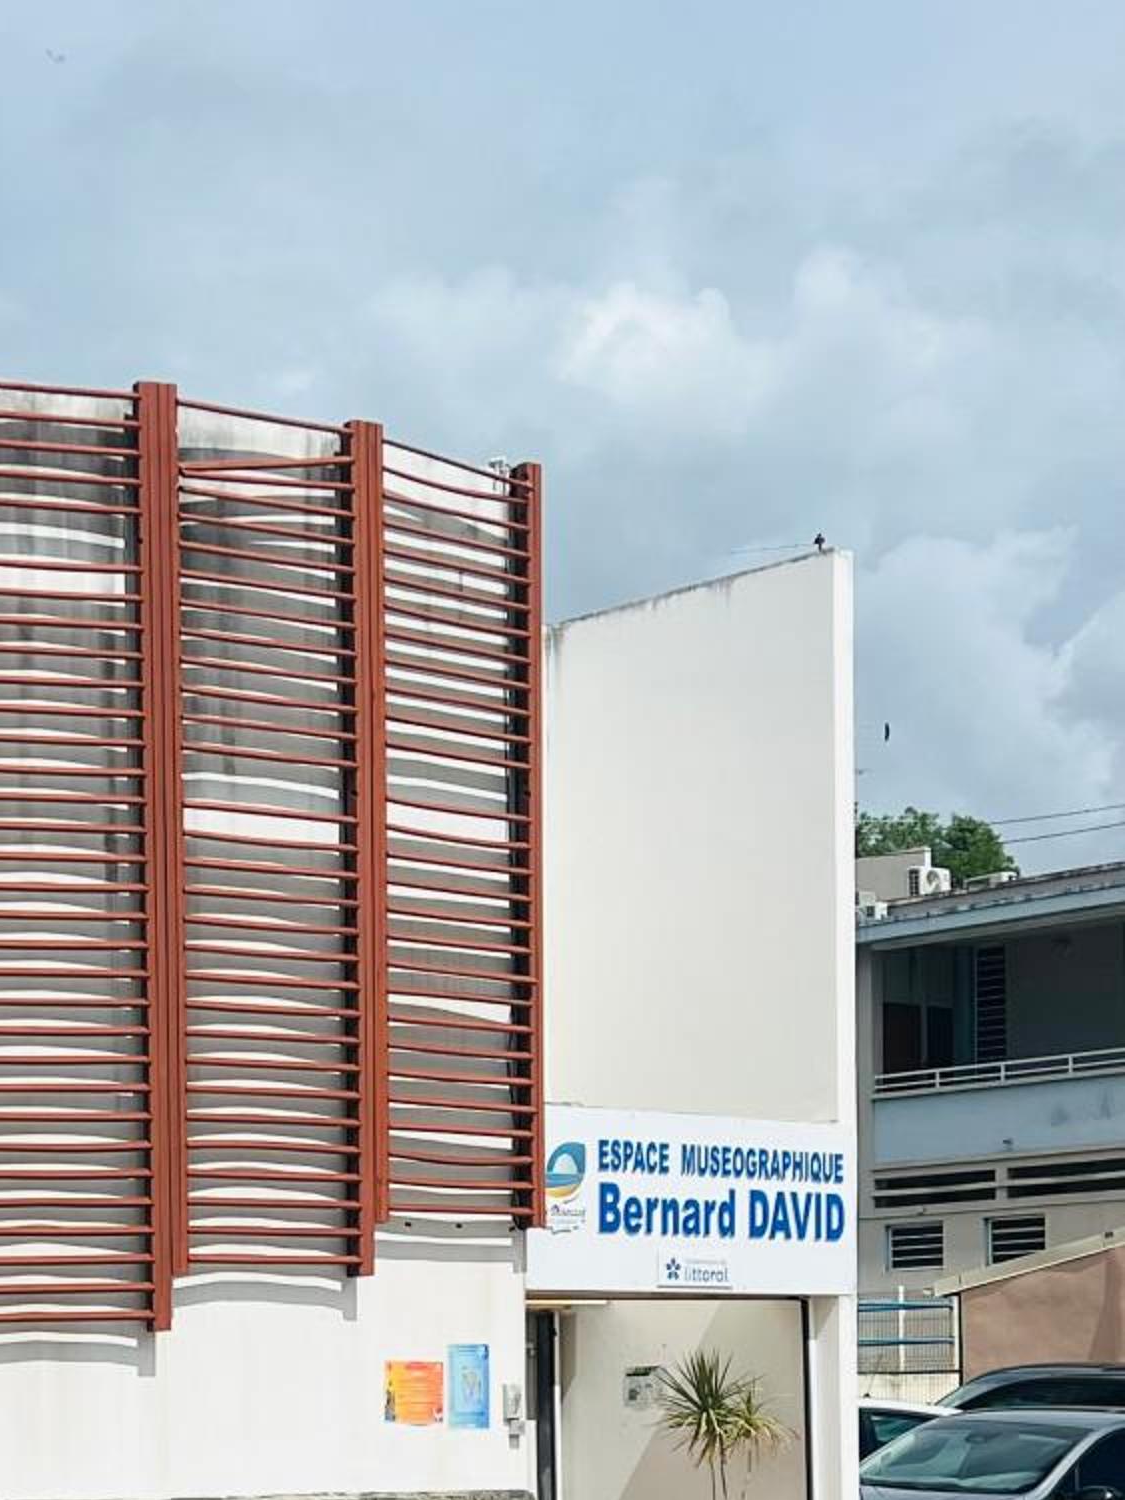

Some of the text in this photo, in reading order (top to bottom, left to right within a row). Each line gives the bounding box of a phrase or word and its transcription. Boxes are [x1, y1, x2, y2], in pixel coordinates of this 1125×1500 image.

[598, 1139, 844, 1184] ESPACE MUSEOGRAPHIQUE
[598, 1181, 845, 1242] Bernard DAVID
